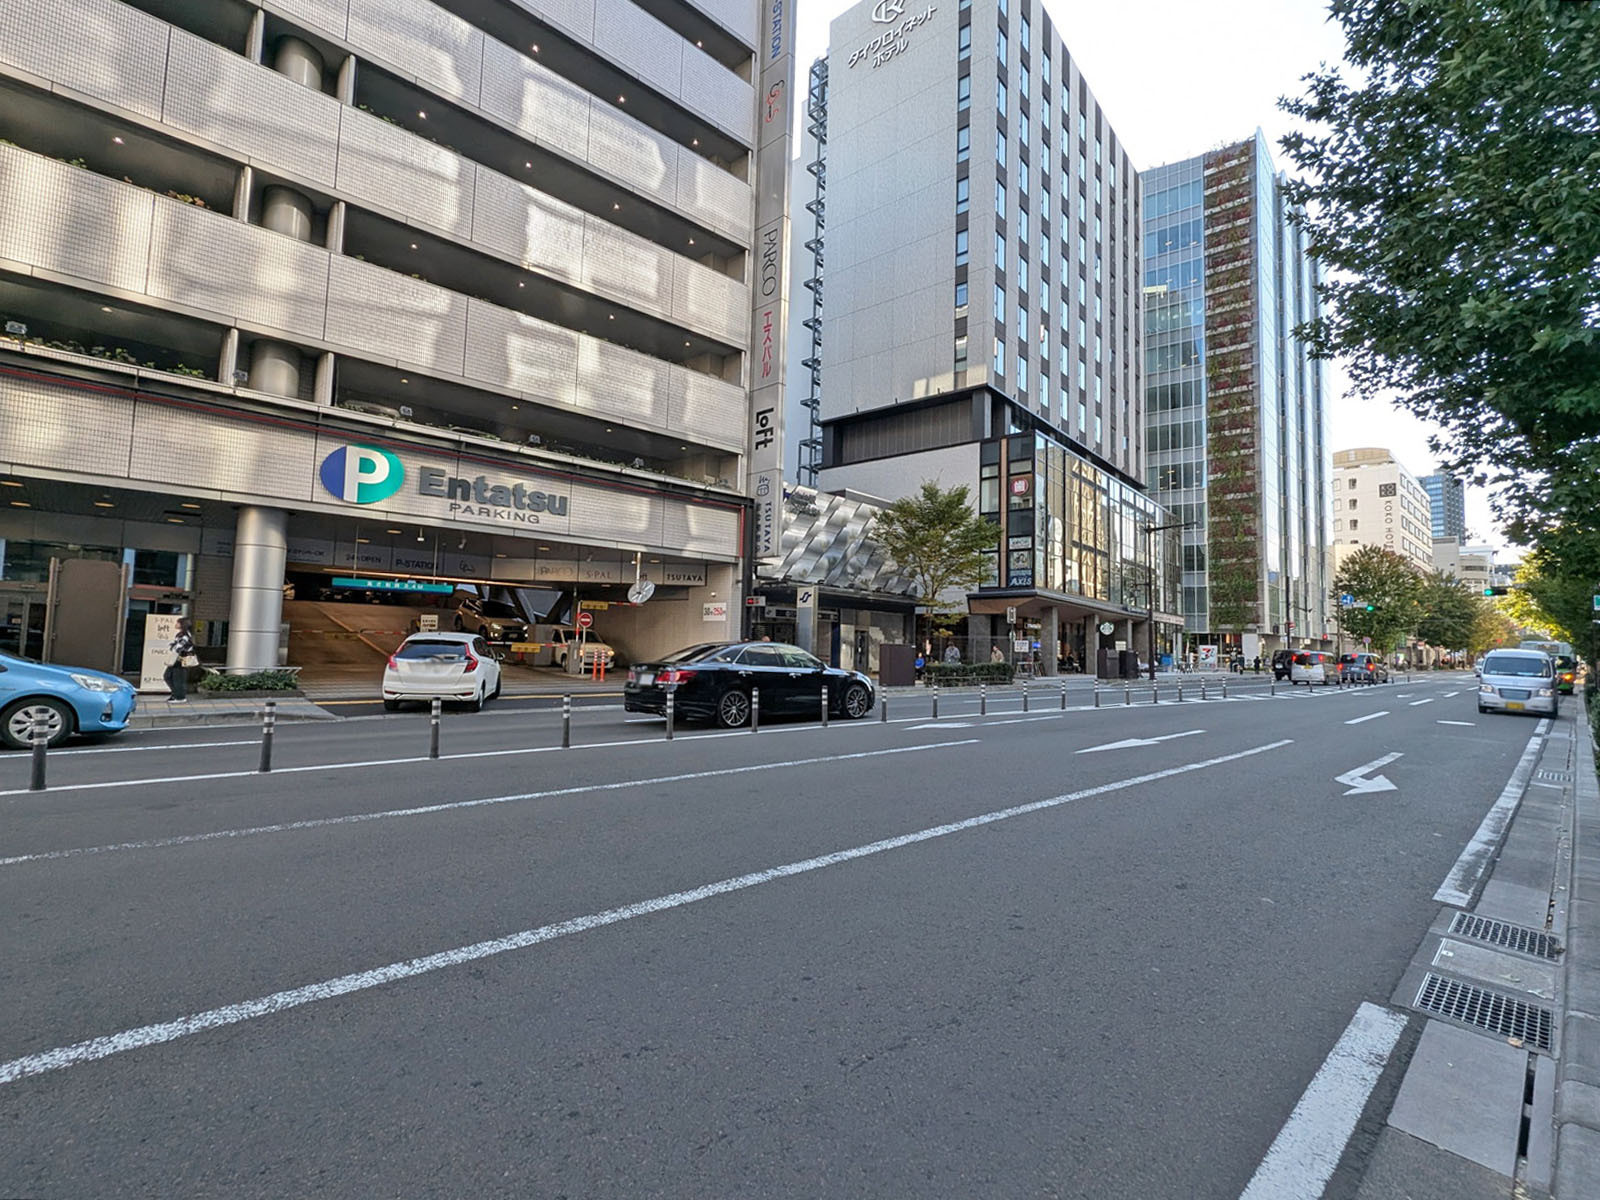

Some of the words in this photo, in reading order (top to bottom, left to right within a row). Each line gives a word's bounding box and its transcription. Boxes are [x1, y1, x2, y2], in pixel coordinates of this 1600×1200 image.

[873, 38, 909, 69] ホテル
[762, 228, 778, 296] PARCO
[343, 445, 390, 503] P
[419, 465, 568, 516] Entatsu
[449, 502, 540, 524] PARKING
[764, 501, 772, 553] TSUTAYA
[1384, 500, 1393, 524] KOKO
[666, 573, 703, 582] TSUTAYA
